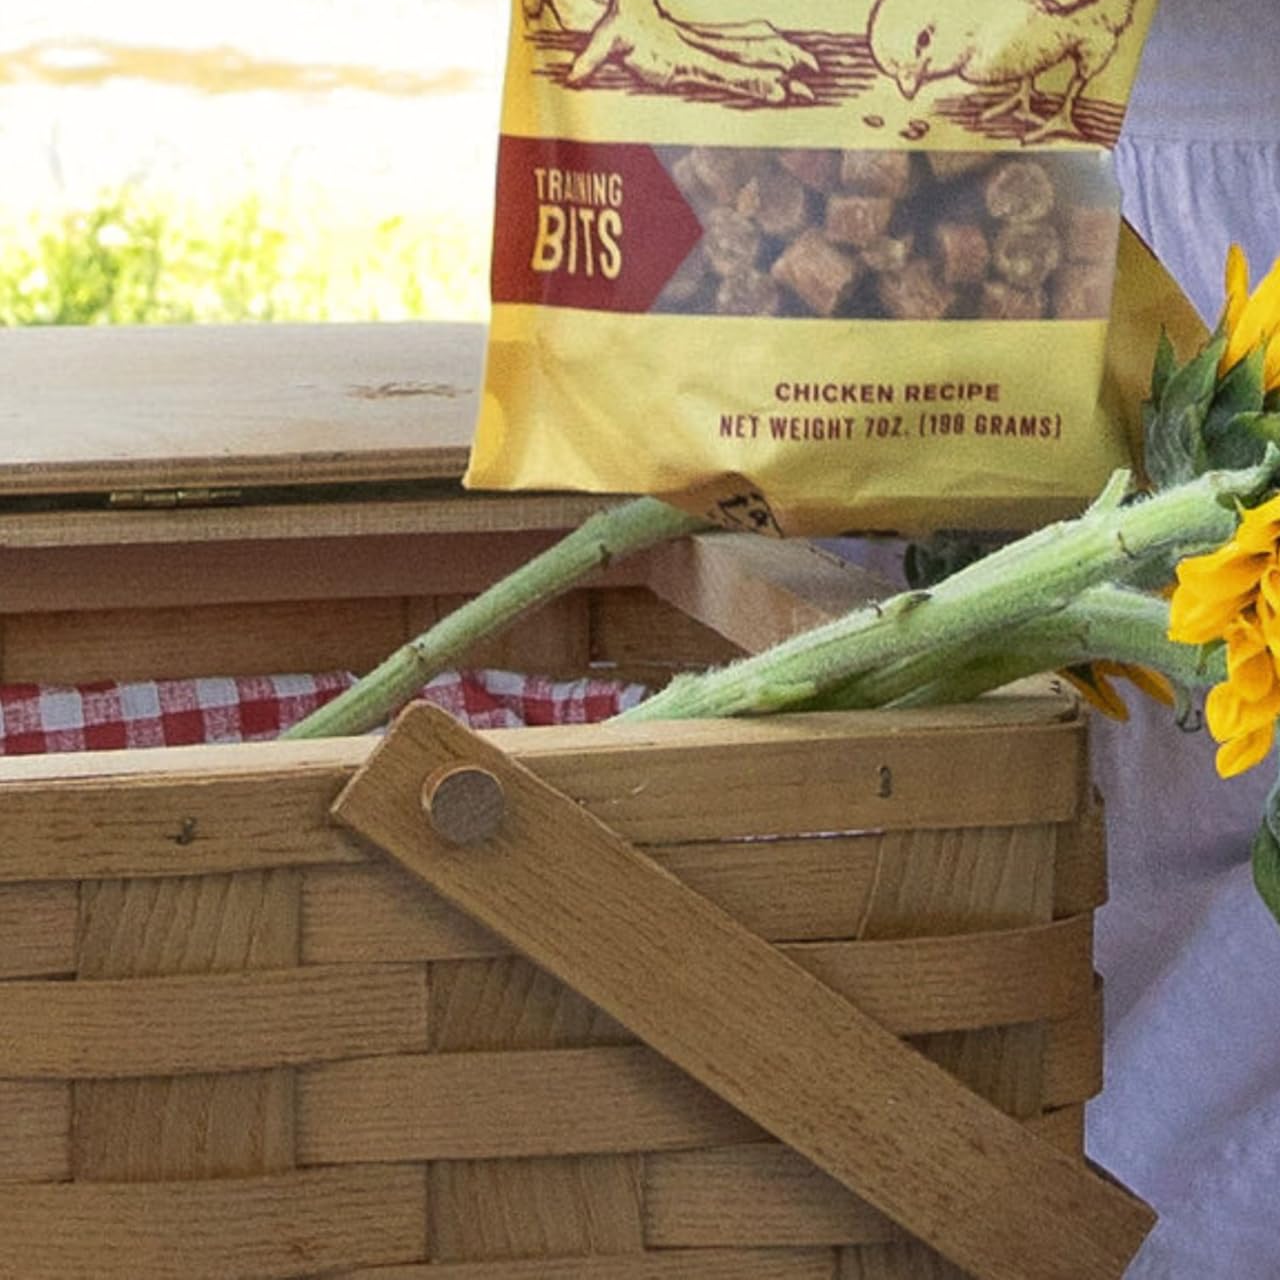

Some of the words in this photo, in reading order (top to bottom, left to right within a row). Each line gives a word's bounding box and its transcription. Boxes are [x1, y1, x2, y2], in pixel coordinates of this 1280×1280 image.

[531, 205, 623, 279] BITS
[774, 383, 894, 403] CHICKEN
[904, 384, 1000, 402] RECIPE
[719, 414, 760, 438] NET
[769, 417, 856, 440] WEIGHT
